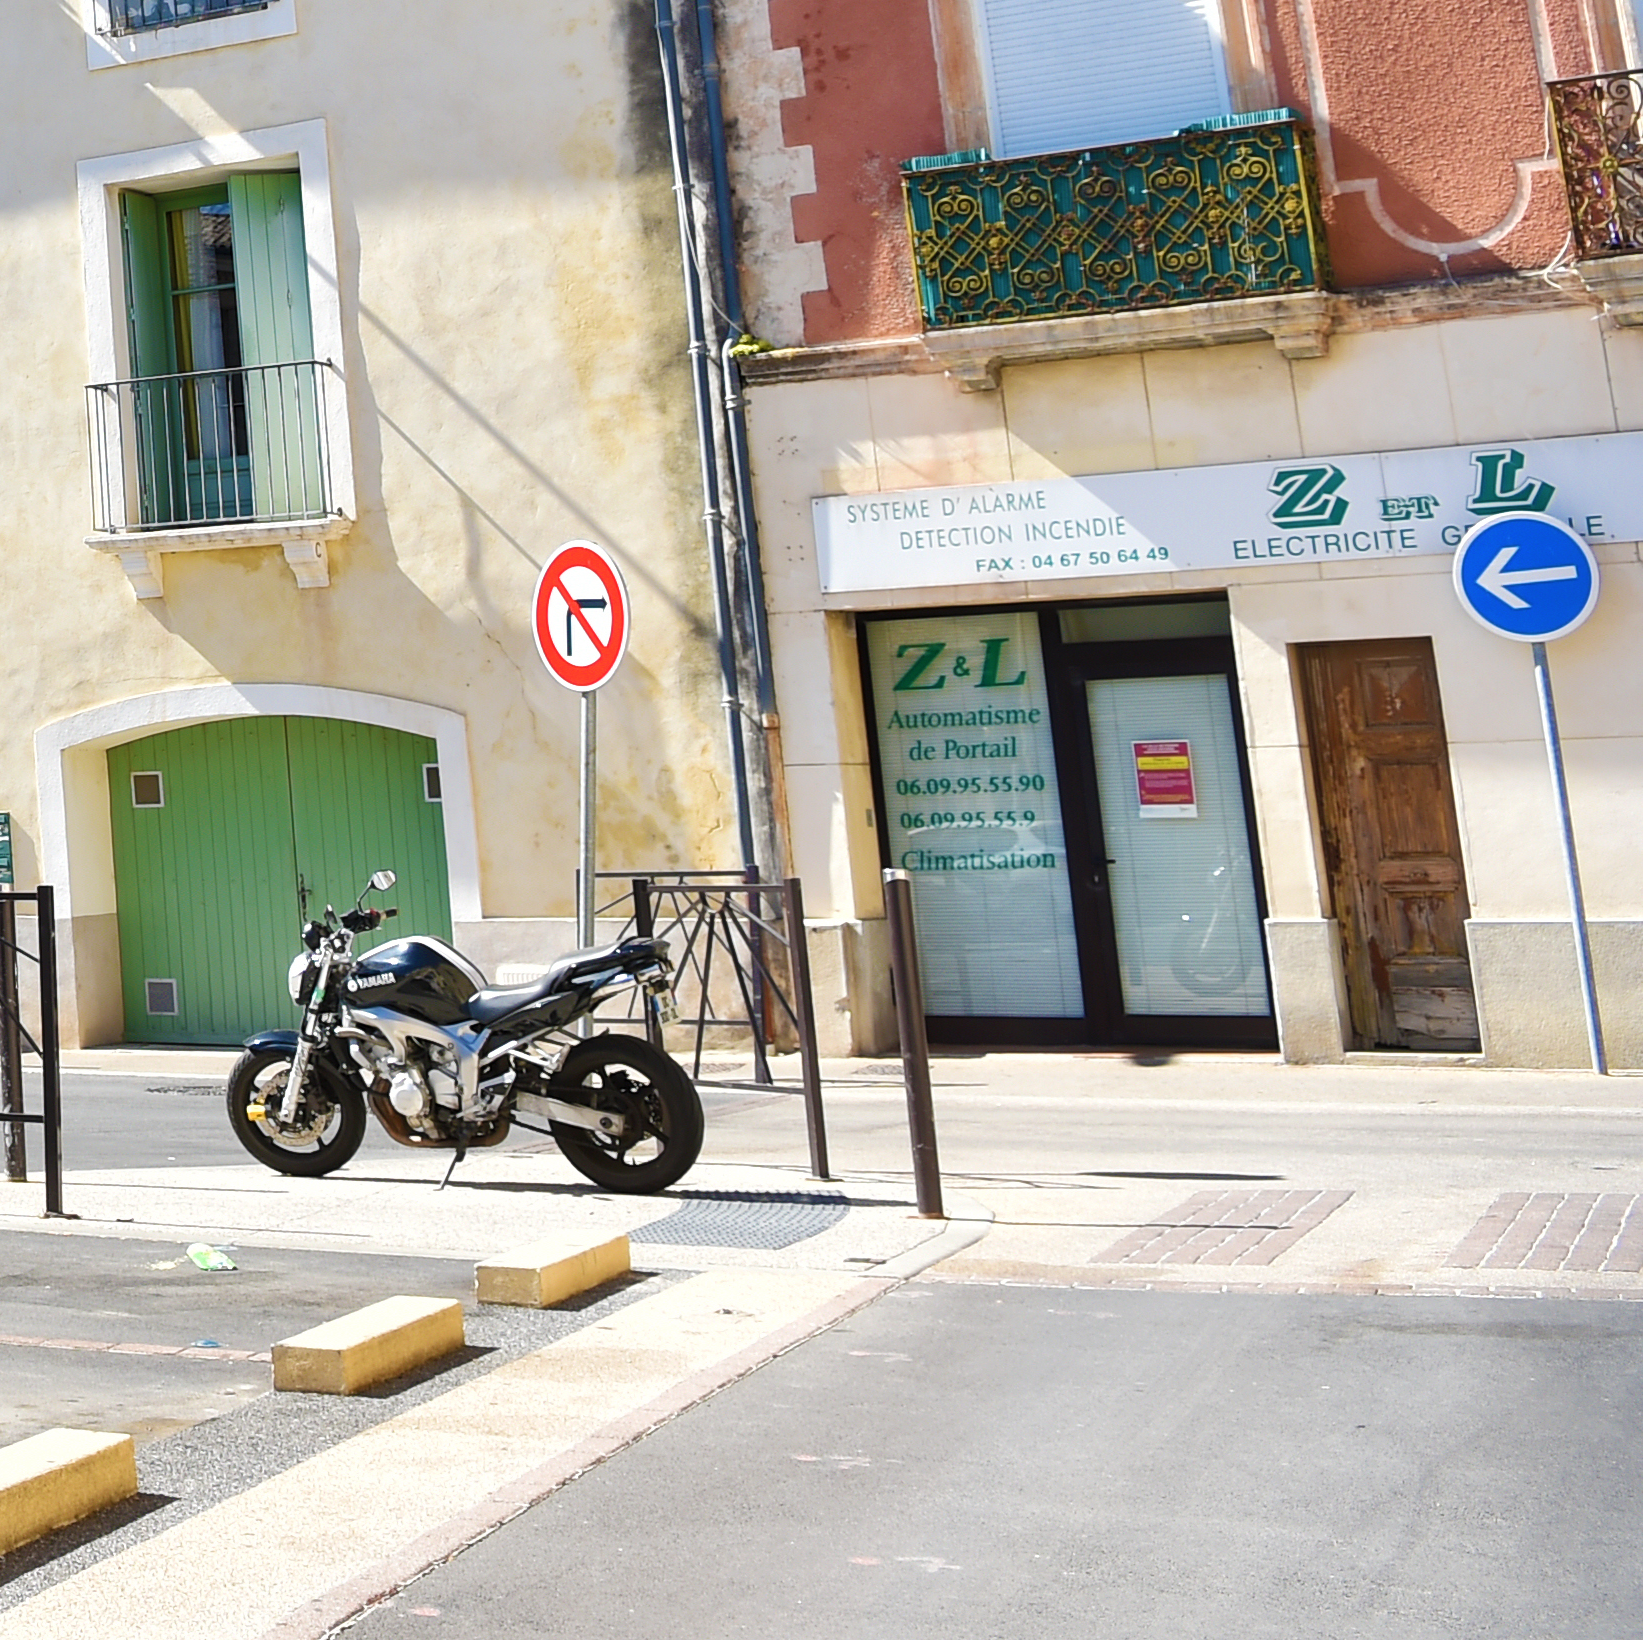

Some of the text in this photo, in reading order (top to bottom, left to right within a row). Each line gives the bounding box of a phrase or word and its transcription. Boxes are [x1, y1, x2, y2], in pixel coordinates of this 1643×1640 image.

[1267, 448, 1556, 530] Z ET L
[847, 490, 1047, 524] SYSTEME D' ALARME
[900, 515, 1127, 550] DETECTION INCENDIE
[1232, 528, 1418, 560] ELECTRICITE
[975, 546, 1169, 573] FAX 04 67 50 64 49
[893, 638, 1027, 691] Z & L
[887, 705, 1041, 729] Automatisme
[909, 736, 1018, 761] de Portail
[896, 774, 1045, 796] 06.09.95.55.90
[901, 847, 1056, 872] Climatisation
[357, 972, 396, 990] YAMAHA
